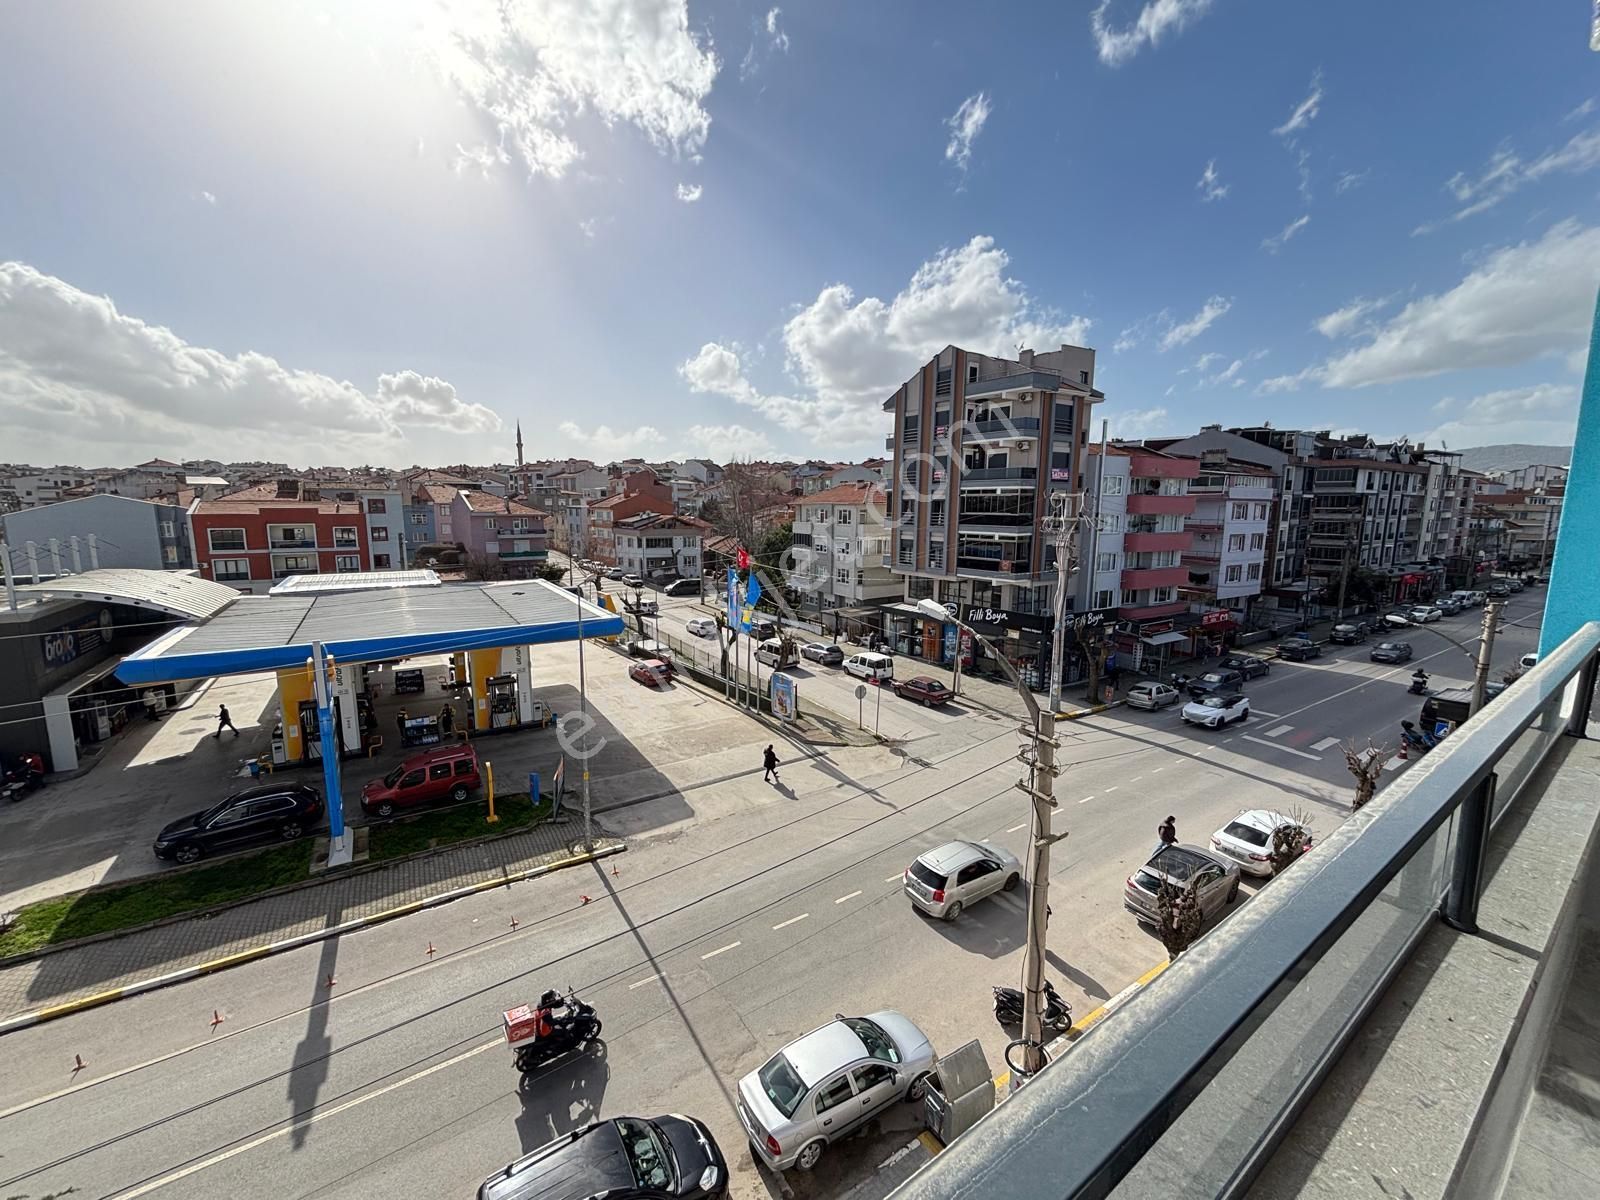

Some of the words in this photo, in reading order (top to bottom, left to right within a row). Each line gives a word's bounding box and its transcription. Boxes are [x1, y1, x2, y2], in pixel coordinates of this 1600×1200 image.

[968, 608, 984, 622] Filli
[985, 608, 1009, 624] Boya
[1087, 612, 1105, 626] Boya
